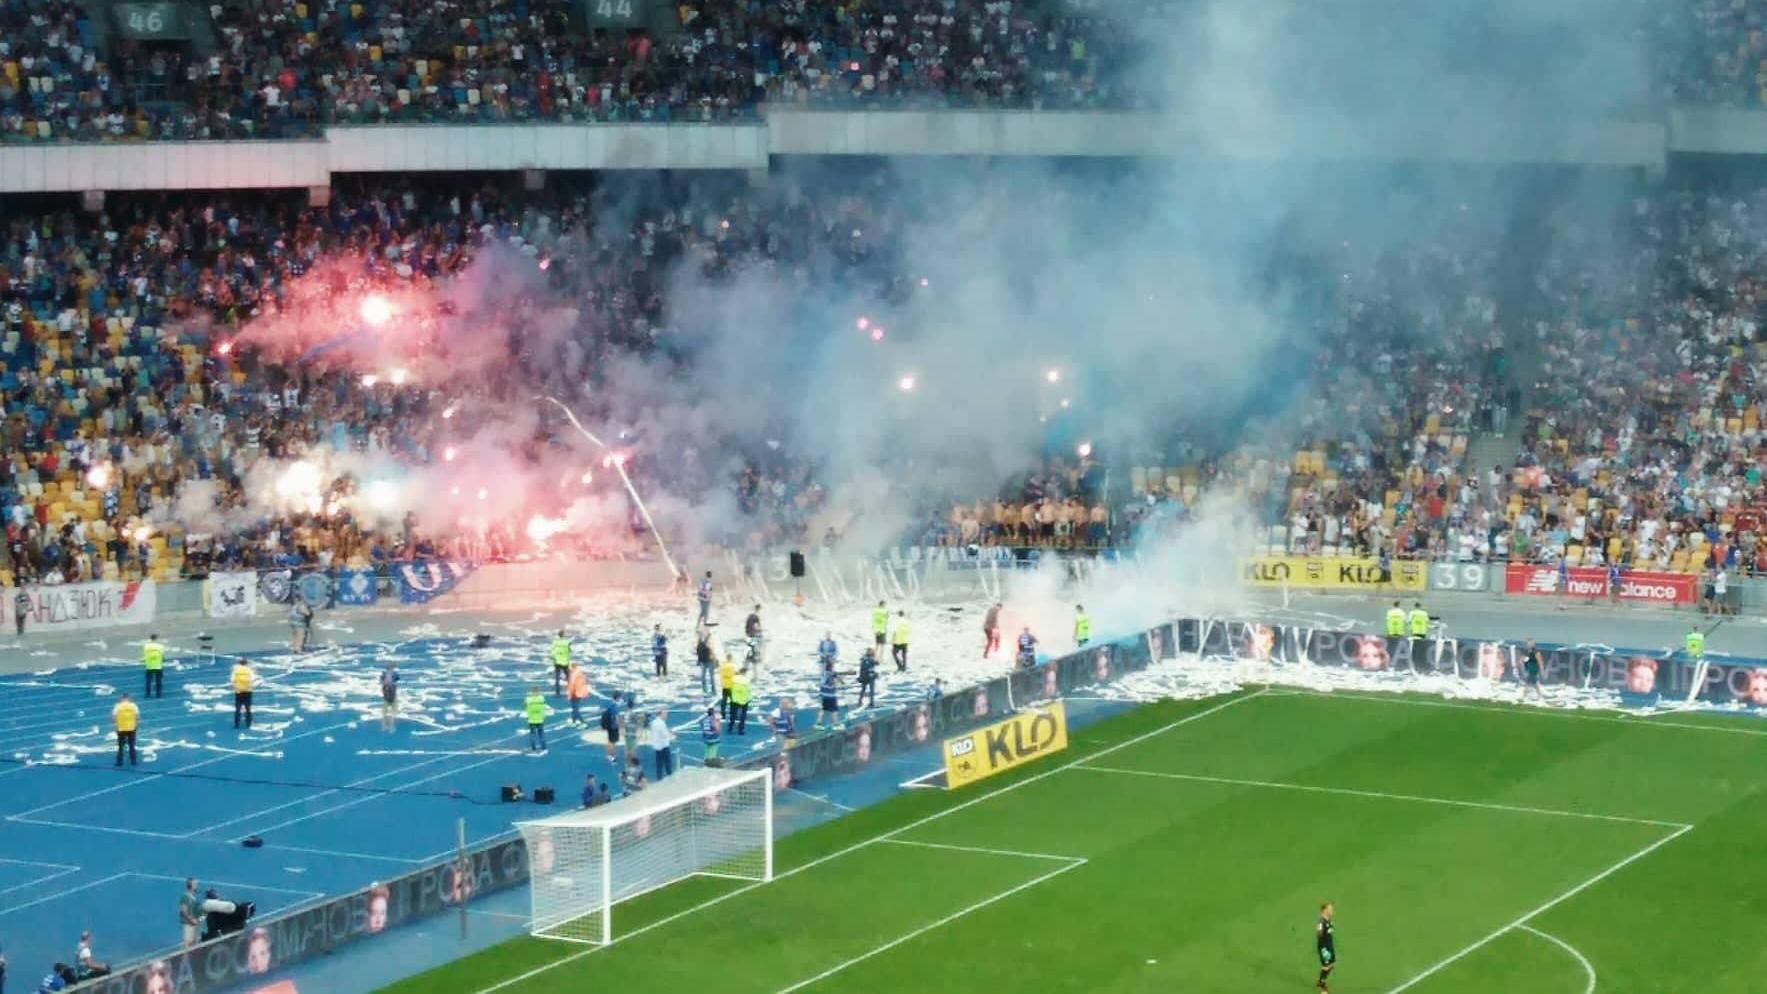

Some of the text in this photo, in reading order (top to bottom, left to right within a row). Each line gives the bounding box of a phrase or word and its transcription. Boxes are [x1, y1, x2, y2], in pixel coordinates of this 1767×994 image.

[597, 0, 632, 18] 44
[128, 11, 162, 32] 46
[1437, 563, 1483, 588] 39
[1567, 580, 1604, 594] new
[952, 739, 974, 755] KLO
[986, 714, 1057, 769] KLO
